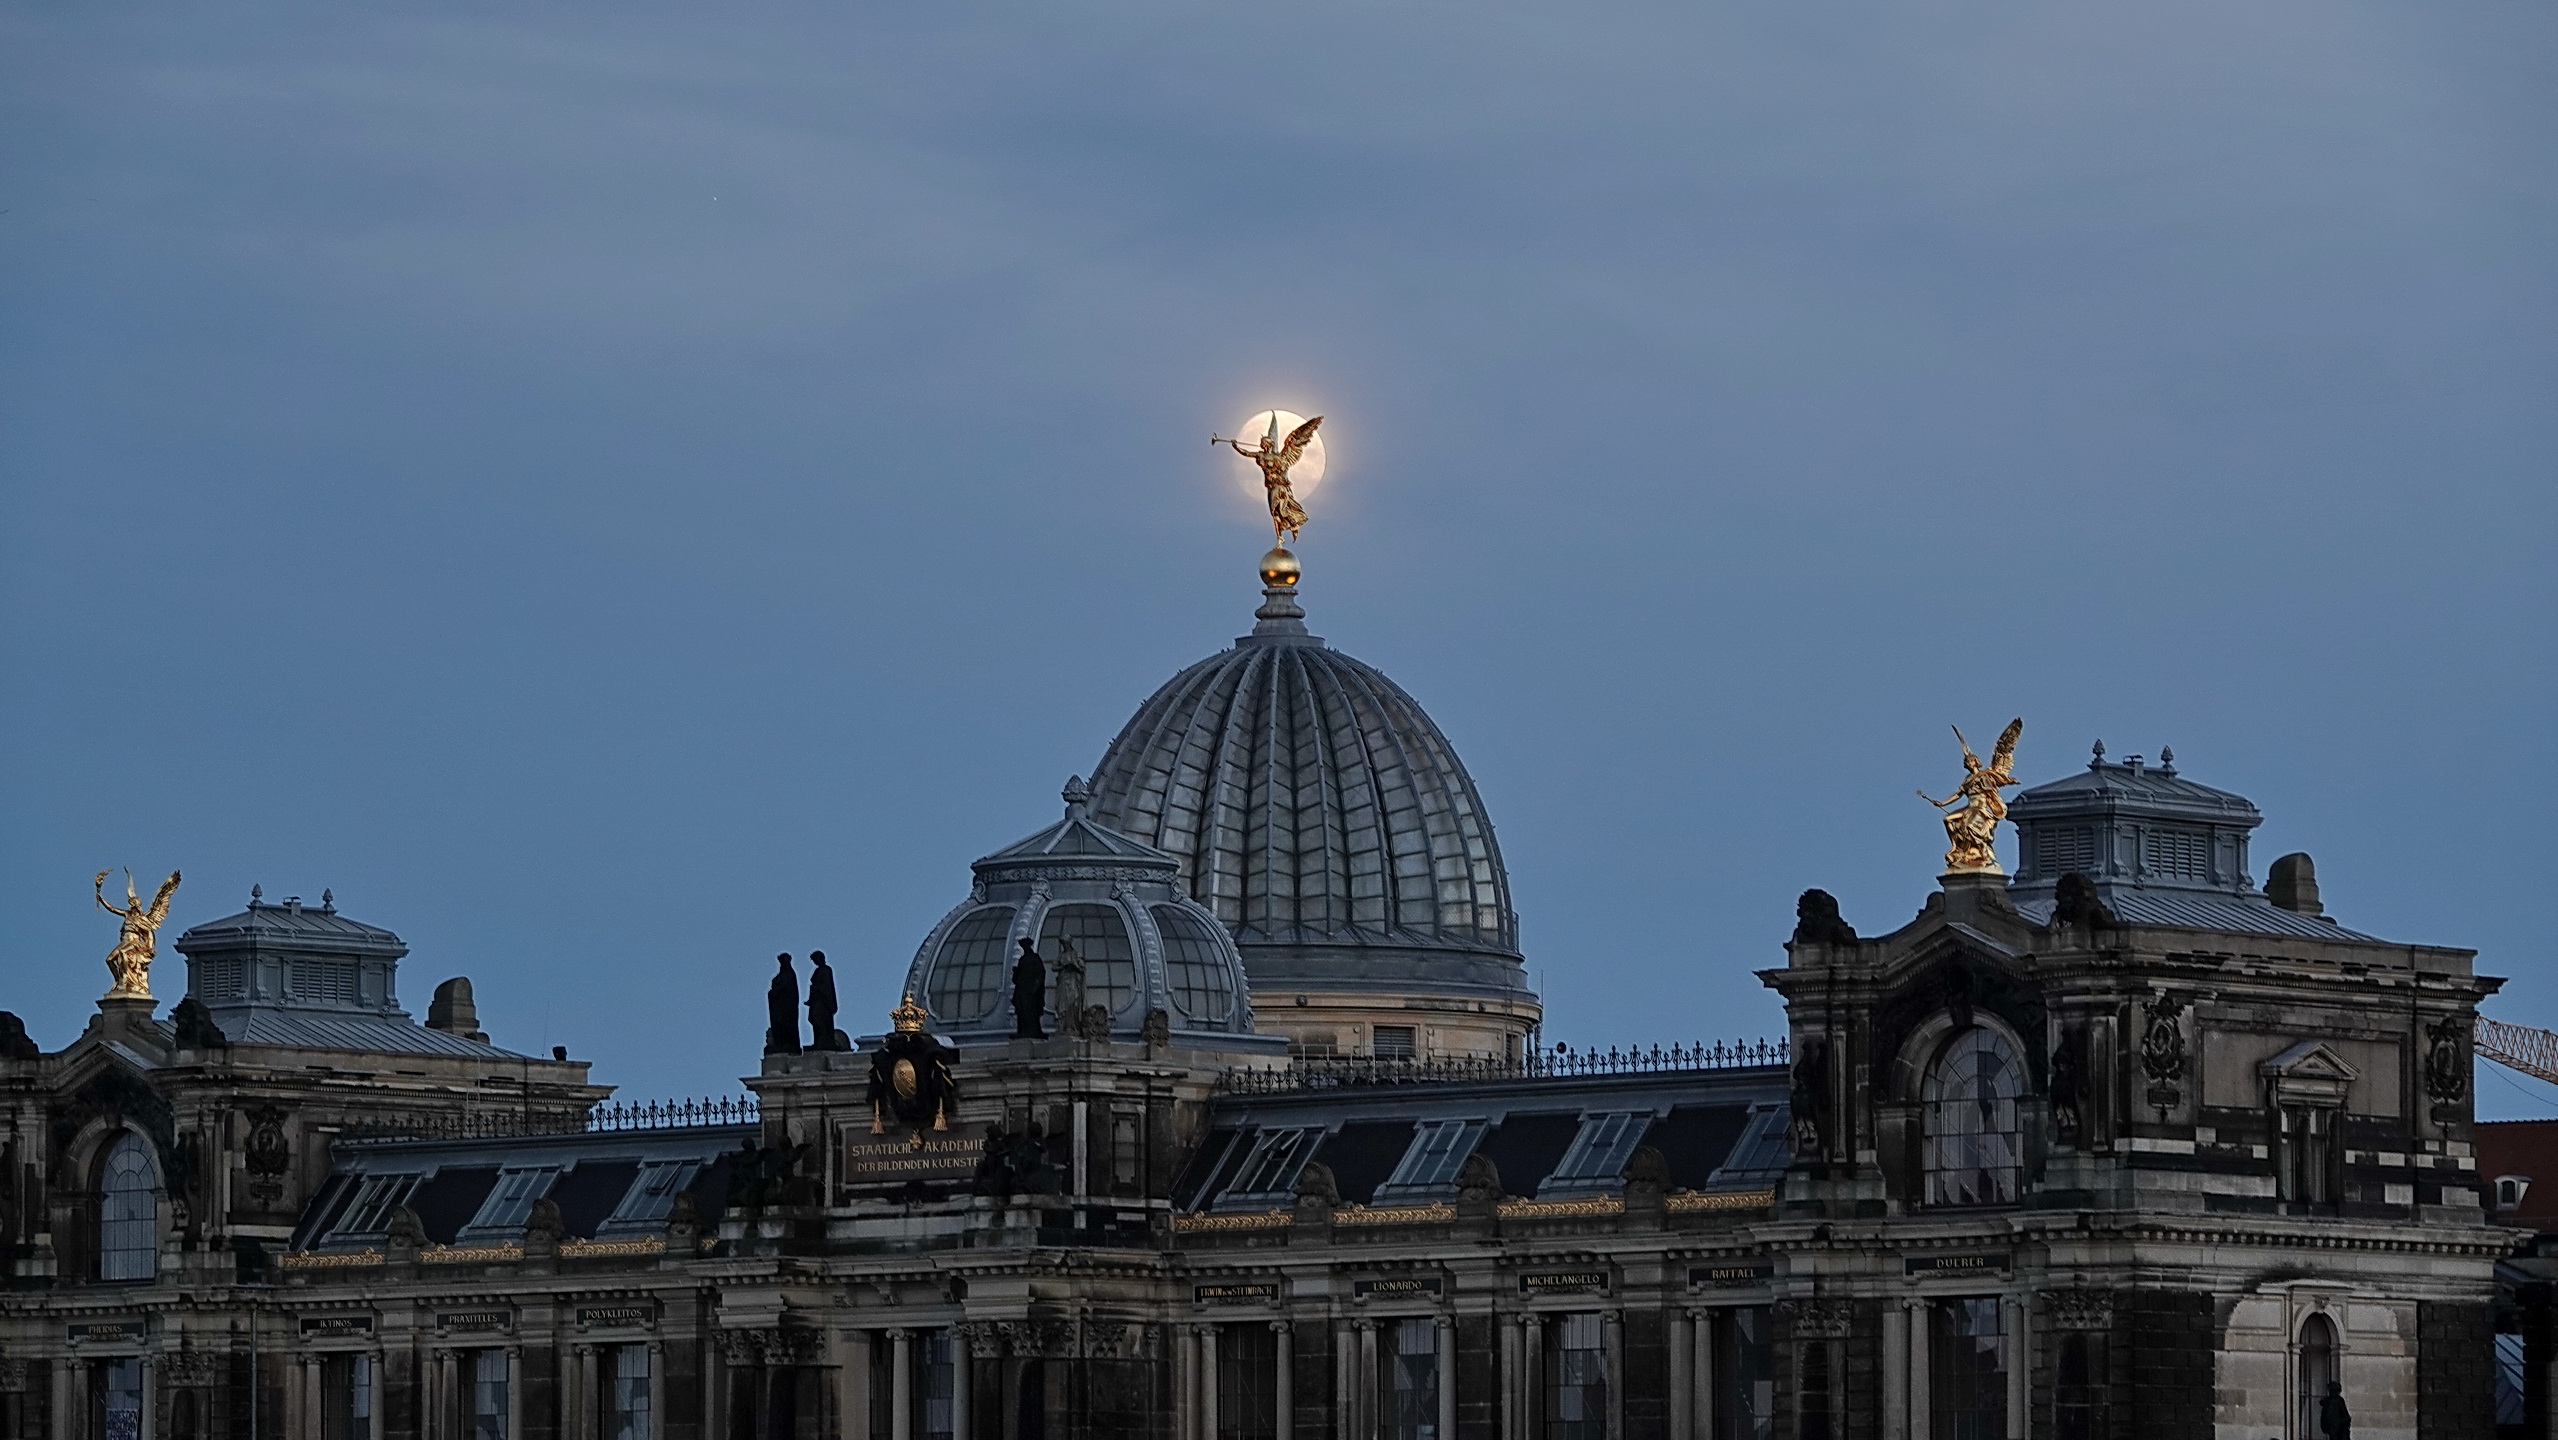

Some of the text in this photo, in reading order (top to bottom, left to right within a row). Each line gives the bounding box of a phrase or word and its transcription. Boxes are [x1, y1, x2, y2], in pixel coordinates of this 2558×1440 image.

[852, 1138, 985, 1157] STAATLICHE AKADEMIE
[858, 1157, 980, 1172] DER BILDENDEN KUENSTE
[1936, 1257, 1984, 1268] DUERER
[1712, 1269, 1755, 1279] RAFFAEL
[1527, 1274, 1600, 1286] MICHELANGELO
[449, 1314, 498, 1324] PRAXITELES
[586, 1309, 642, 1319] POLYKLEITOS
[320, 1319, 352, 1328] IKTINOS
